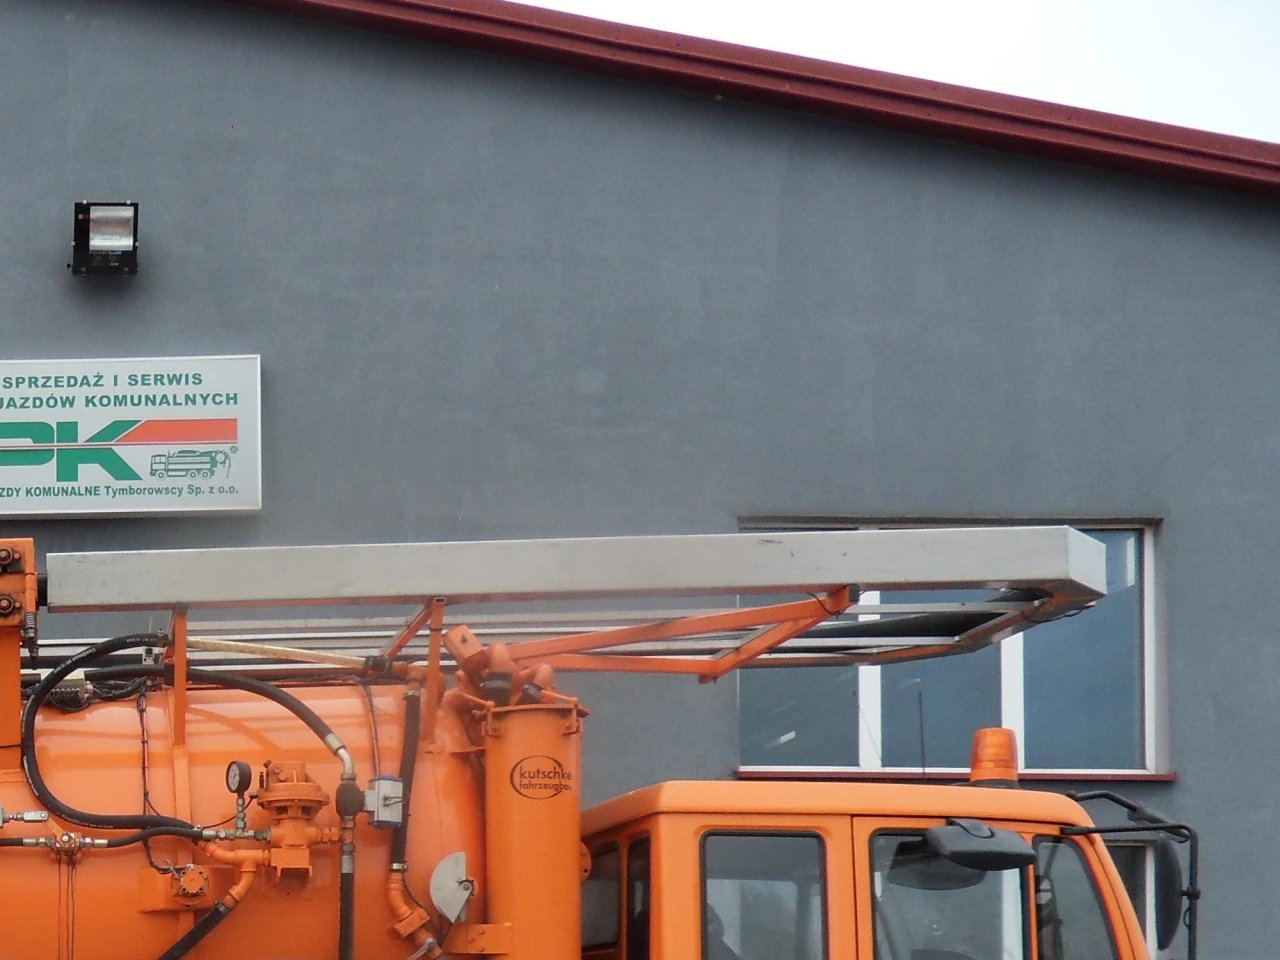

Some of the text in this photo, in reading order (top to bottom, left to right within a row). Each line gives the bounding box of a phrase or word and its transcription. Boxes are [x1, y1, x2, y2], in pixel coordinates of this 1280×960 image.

[2, 371, 203, 389] SPRZEDAŻ I SERWIS
[84, 392, 239, 408] KOMUNALNYCH
[25, 485, 101, 498] KOMUNALNE
[104, 484, 184, 498] Tymborowscy
[187, 484, 205, 498] Sp.
[208, 486, 215, 494] z
[218, 485, 239, 495] o.o.
[520, 766, 572, 780] kutschke
[520, 780, 572, 792] fahrzeugbau
